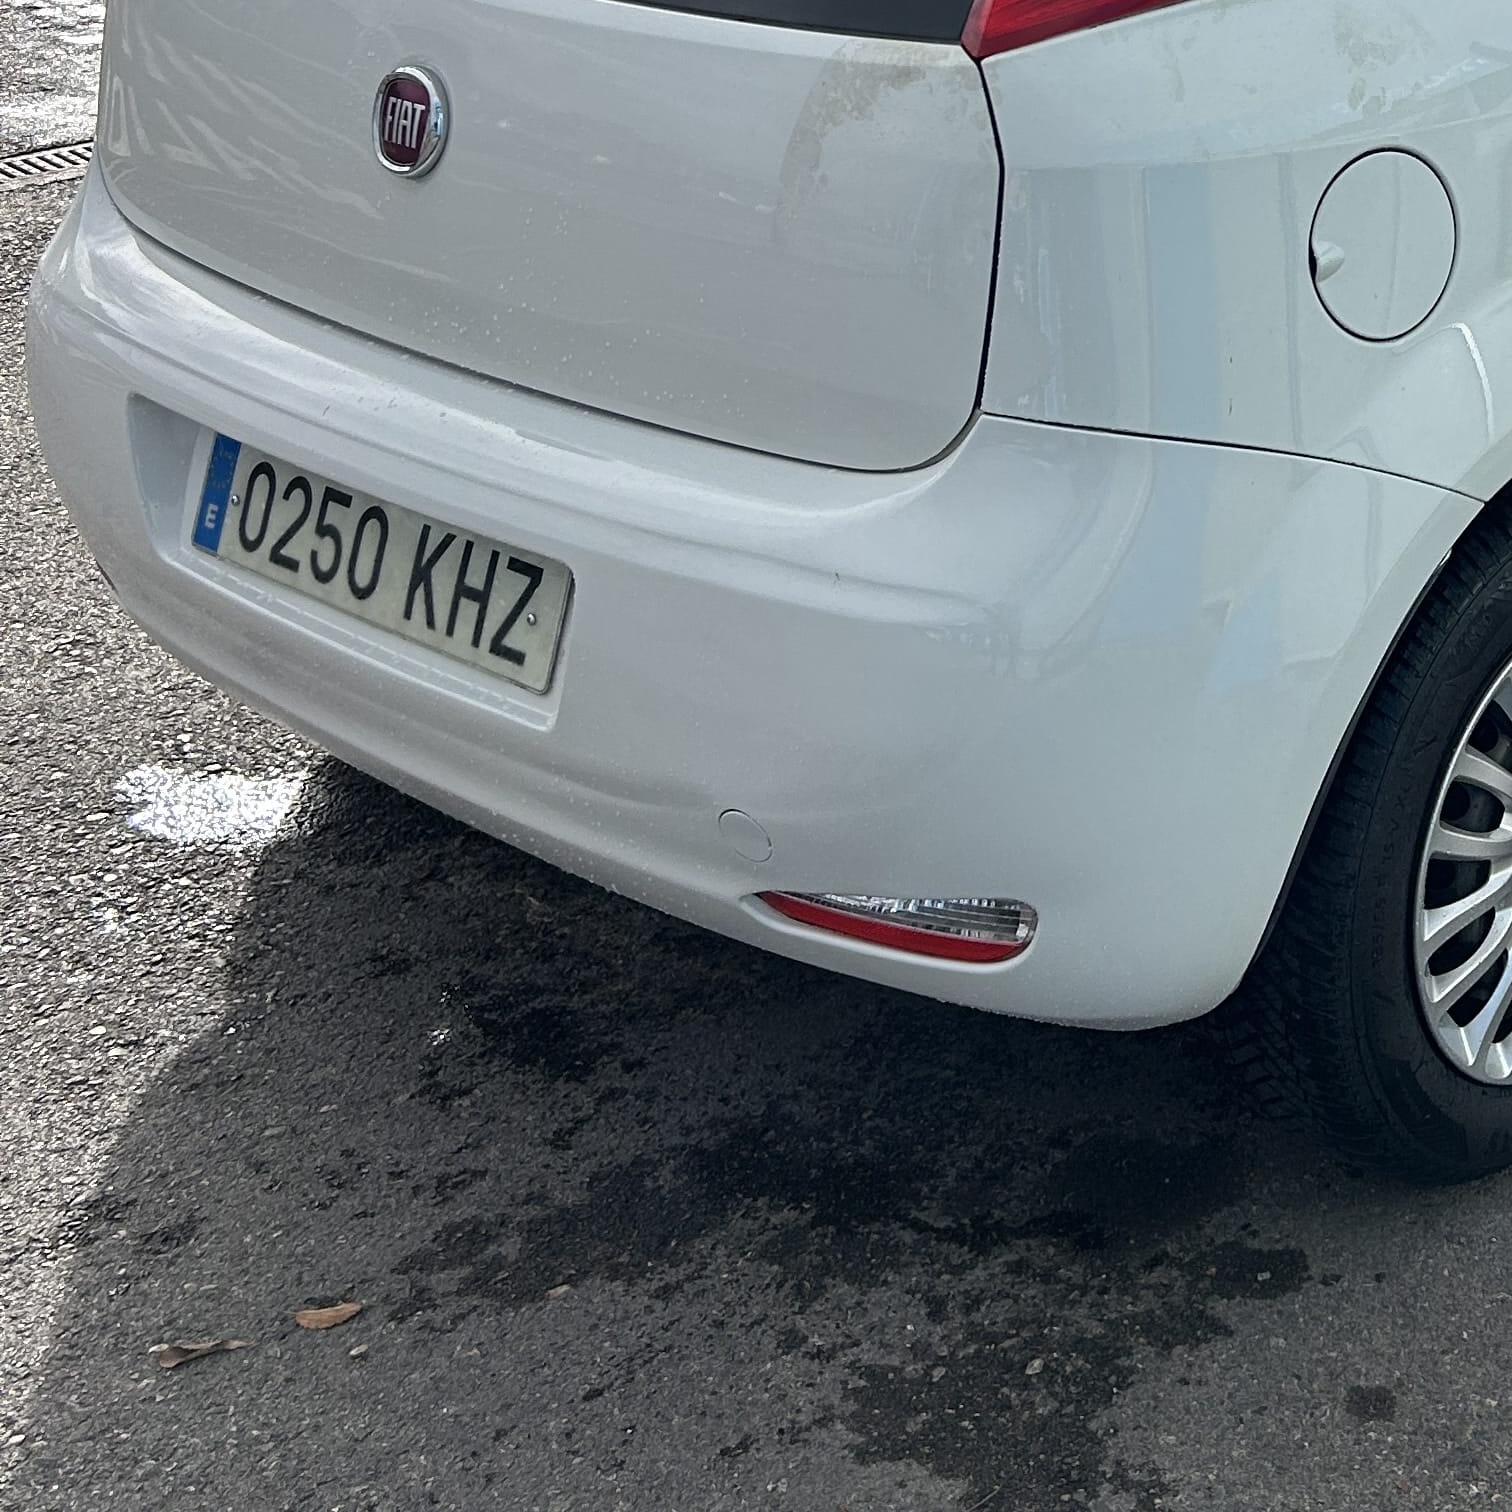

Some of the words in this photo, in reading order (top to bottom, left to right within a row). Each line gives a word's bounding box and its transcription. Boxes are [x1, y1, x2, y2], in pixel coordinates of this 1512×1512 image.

[383, 96, 426, 150] FIAT
[204, 502, 218, 530] E
[238, 460, 390, 601] 0250
[402, 523, 545, 667] KHZ
